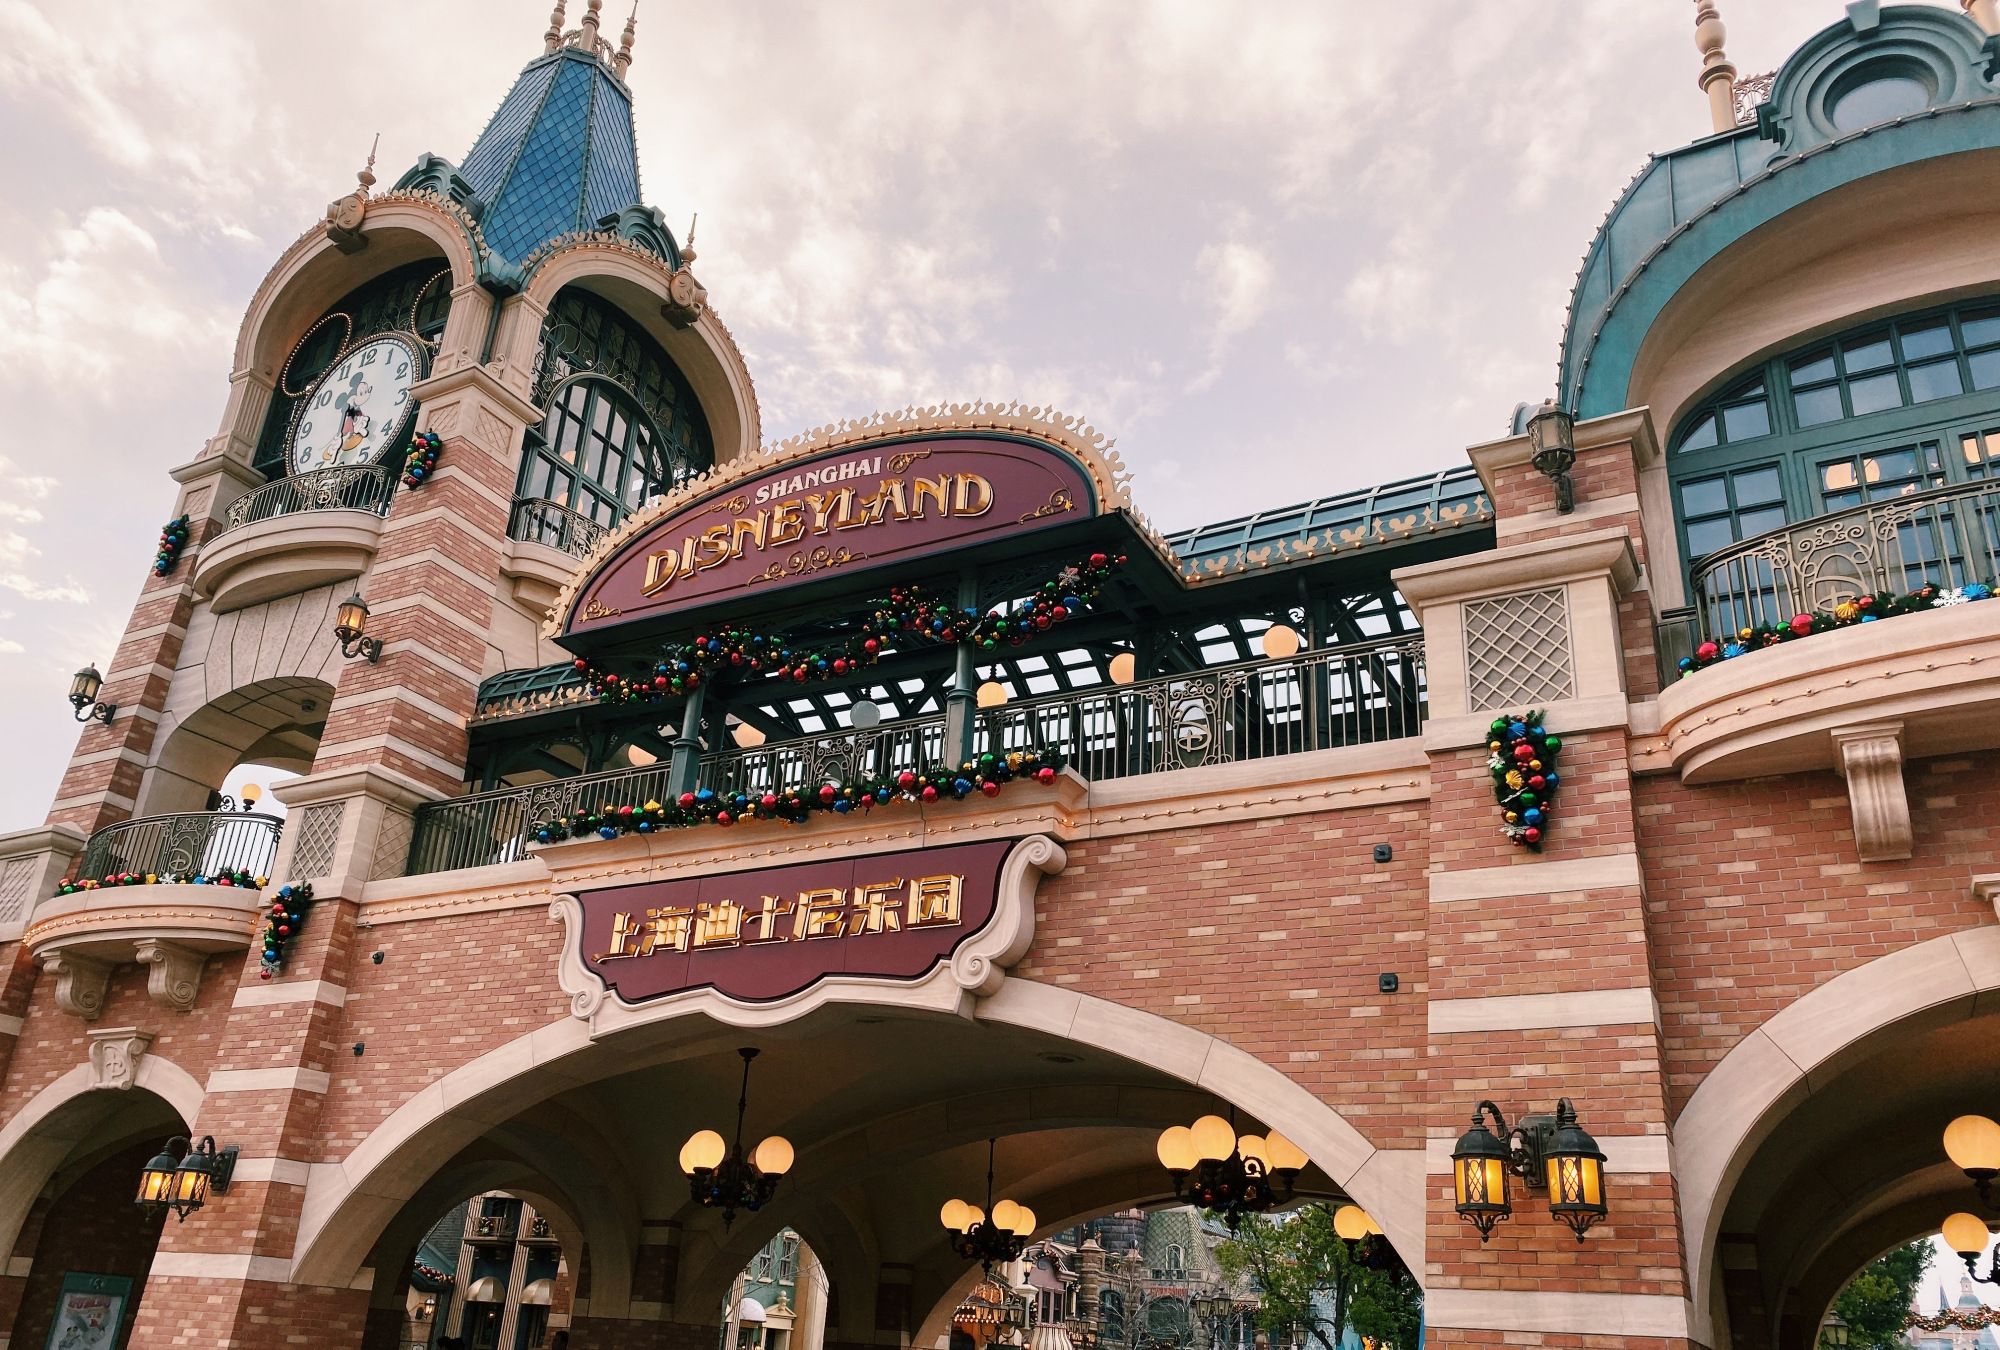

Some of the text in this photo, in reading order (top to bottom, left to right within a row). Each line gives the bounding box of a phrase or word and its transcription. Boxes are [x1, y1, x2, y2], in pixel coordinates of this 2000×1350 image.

[358, 348, 378, 369] 12
[338, 363, 351, 381] 11
[395, 362, 408, 380] 2
[314, 390, 332, 410] 10
[395, 388, 408, 406] 3
[301, 422, 312, 439] 9
[381, 419, 393, 437] 4
[300, 447, 312, 464] 8
[357, 446, 370, 464] 5
[754, 456, 881, 505] SHANGHAI
[639, 472, 994, 598] DISNEYLAND
[590, 873, 966, 964] 上海迪士尼乐园
